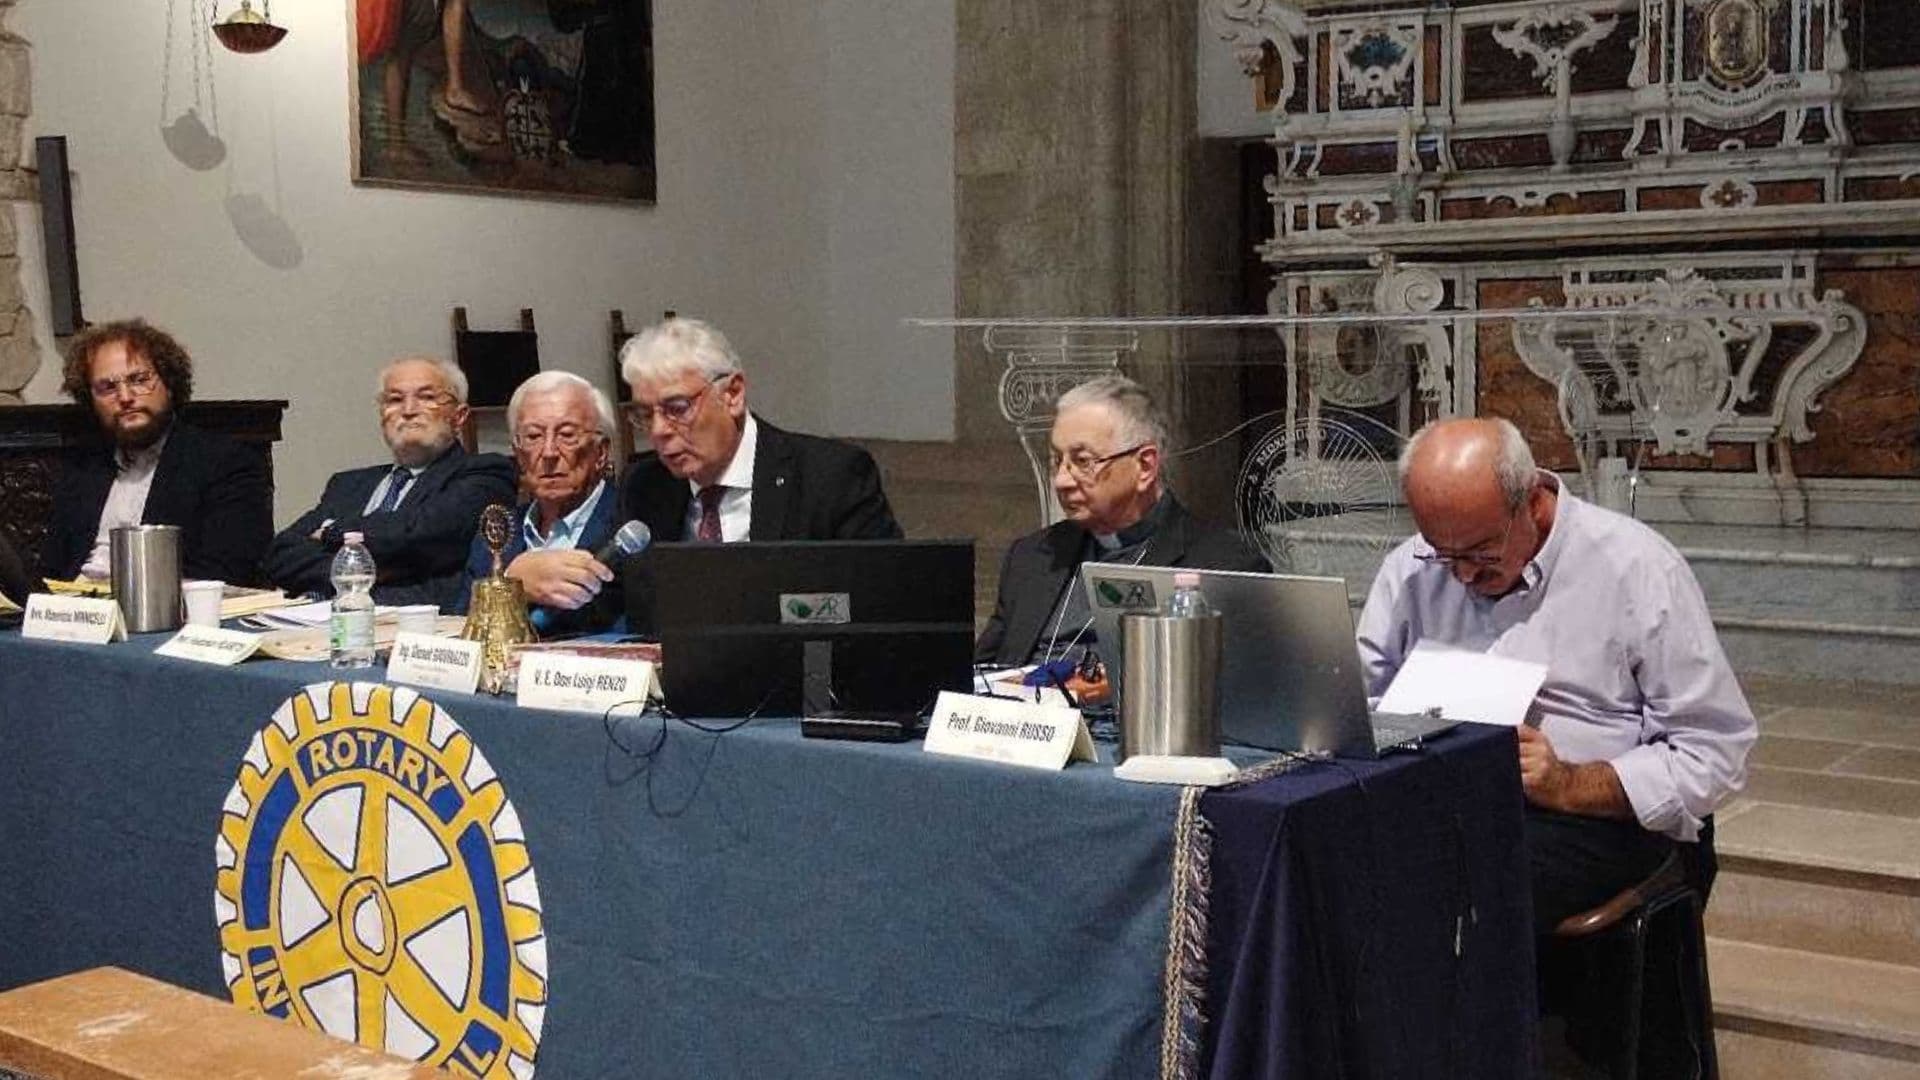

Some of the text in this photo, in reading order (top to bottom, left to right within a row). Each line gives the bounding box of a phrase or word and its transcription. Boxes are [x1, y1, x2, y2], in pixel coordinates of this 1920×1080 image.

[553, 671, 572, 688] Don
[573, 672, 596, 694] Luigi
[596, 675, 628, 692] RENZO
[947, 712, 1056, 742] Prof. Giovanni RUSSO
[308, 731, 448, 799] ROTARY
